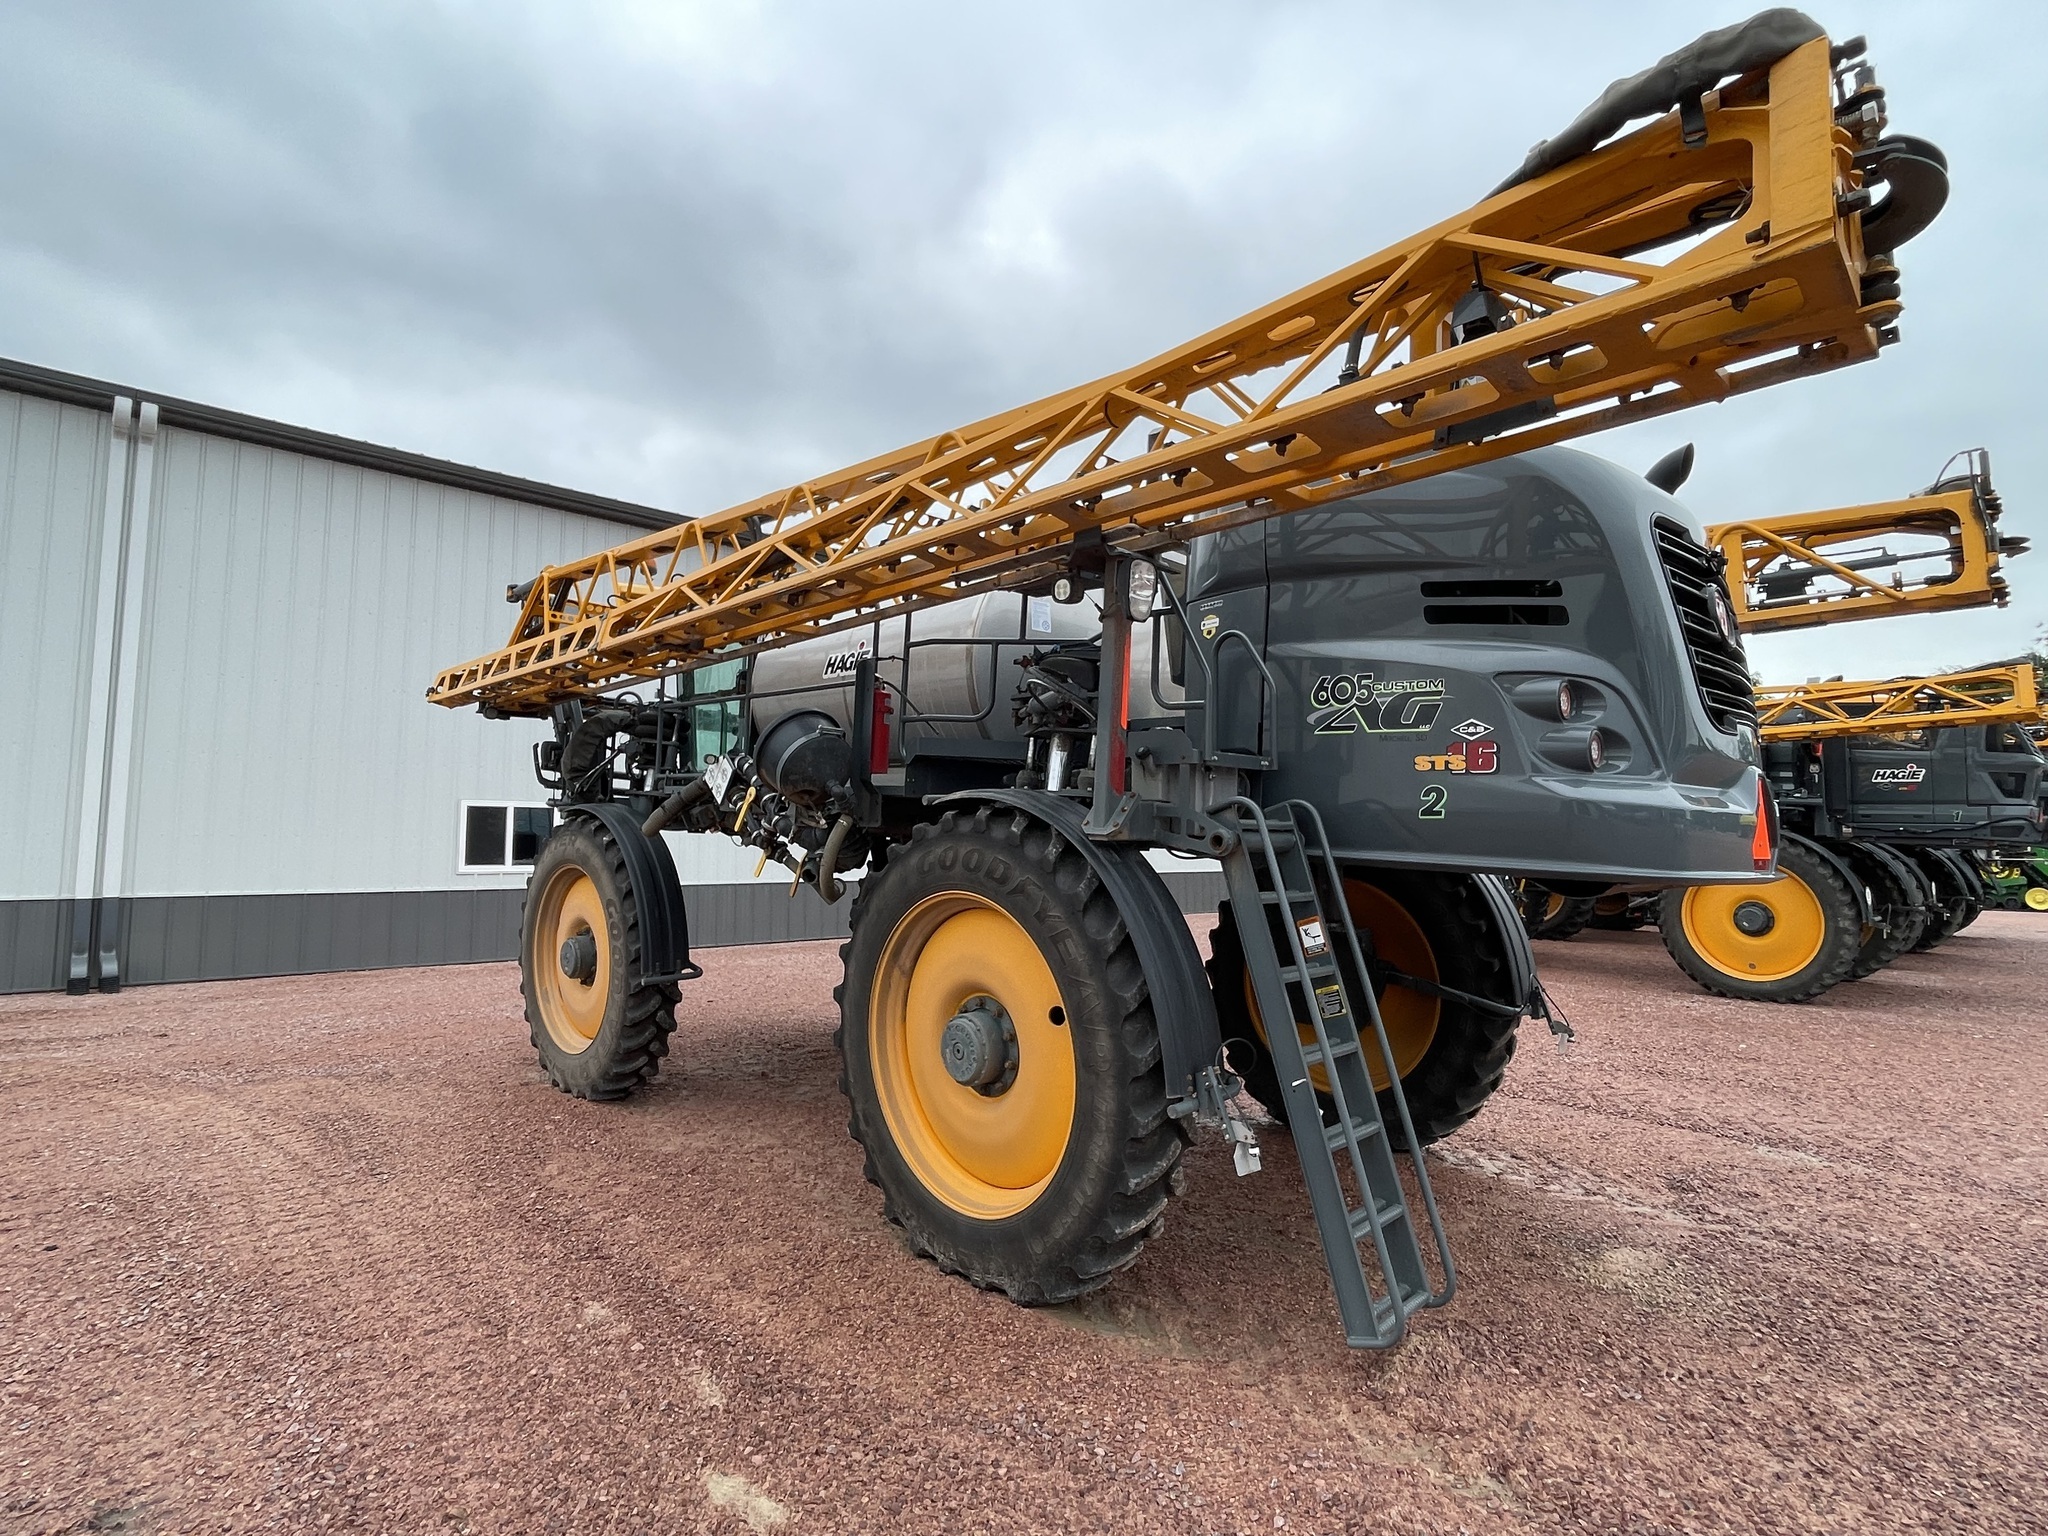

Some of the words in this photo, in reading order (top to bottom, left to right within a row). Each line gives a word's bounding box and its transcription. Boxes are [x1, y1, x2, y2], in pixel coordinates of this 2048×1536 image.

[1311, 672, 1376, 709] 605
[1371, 679, 1445, 694] CUSTOM
[1314, 689, 1446, 735] AG
[1459, 725, 1486, 733] C&B
[1413, 755, 1467, 772] STS
[1446, 740, 1499, 775] 16
[1872, 763, 1926, 782] HAGIE
[1418, 784, 1448, 819] 2
[1952, 809, 1963, 823] 1
[915, 846, 1112, 1073] GOODYEAR
